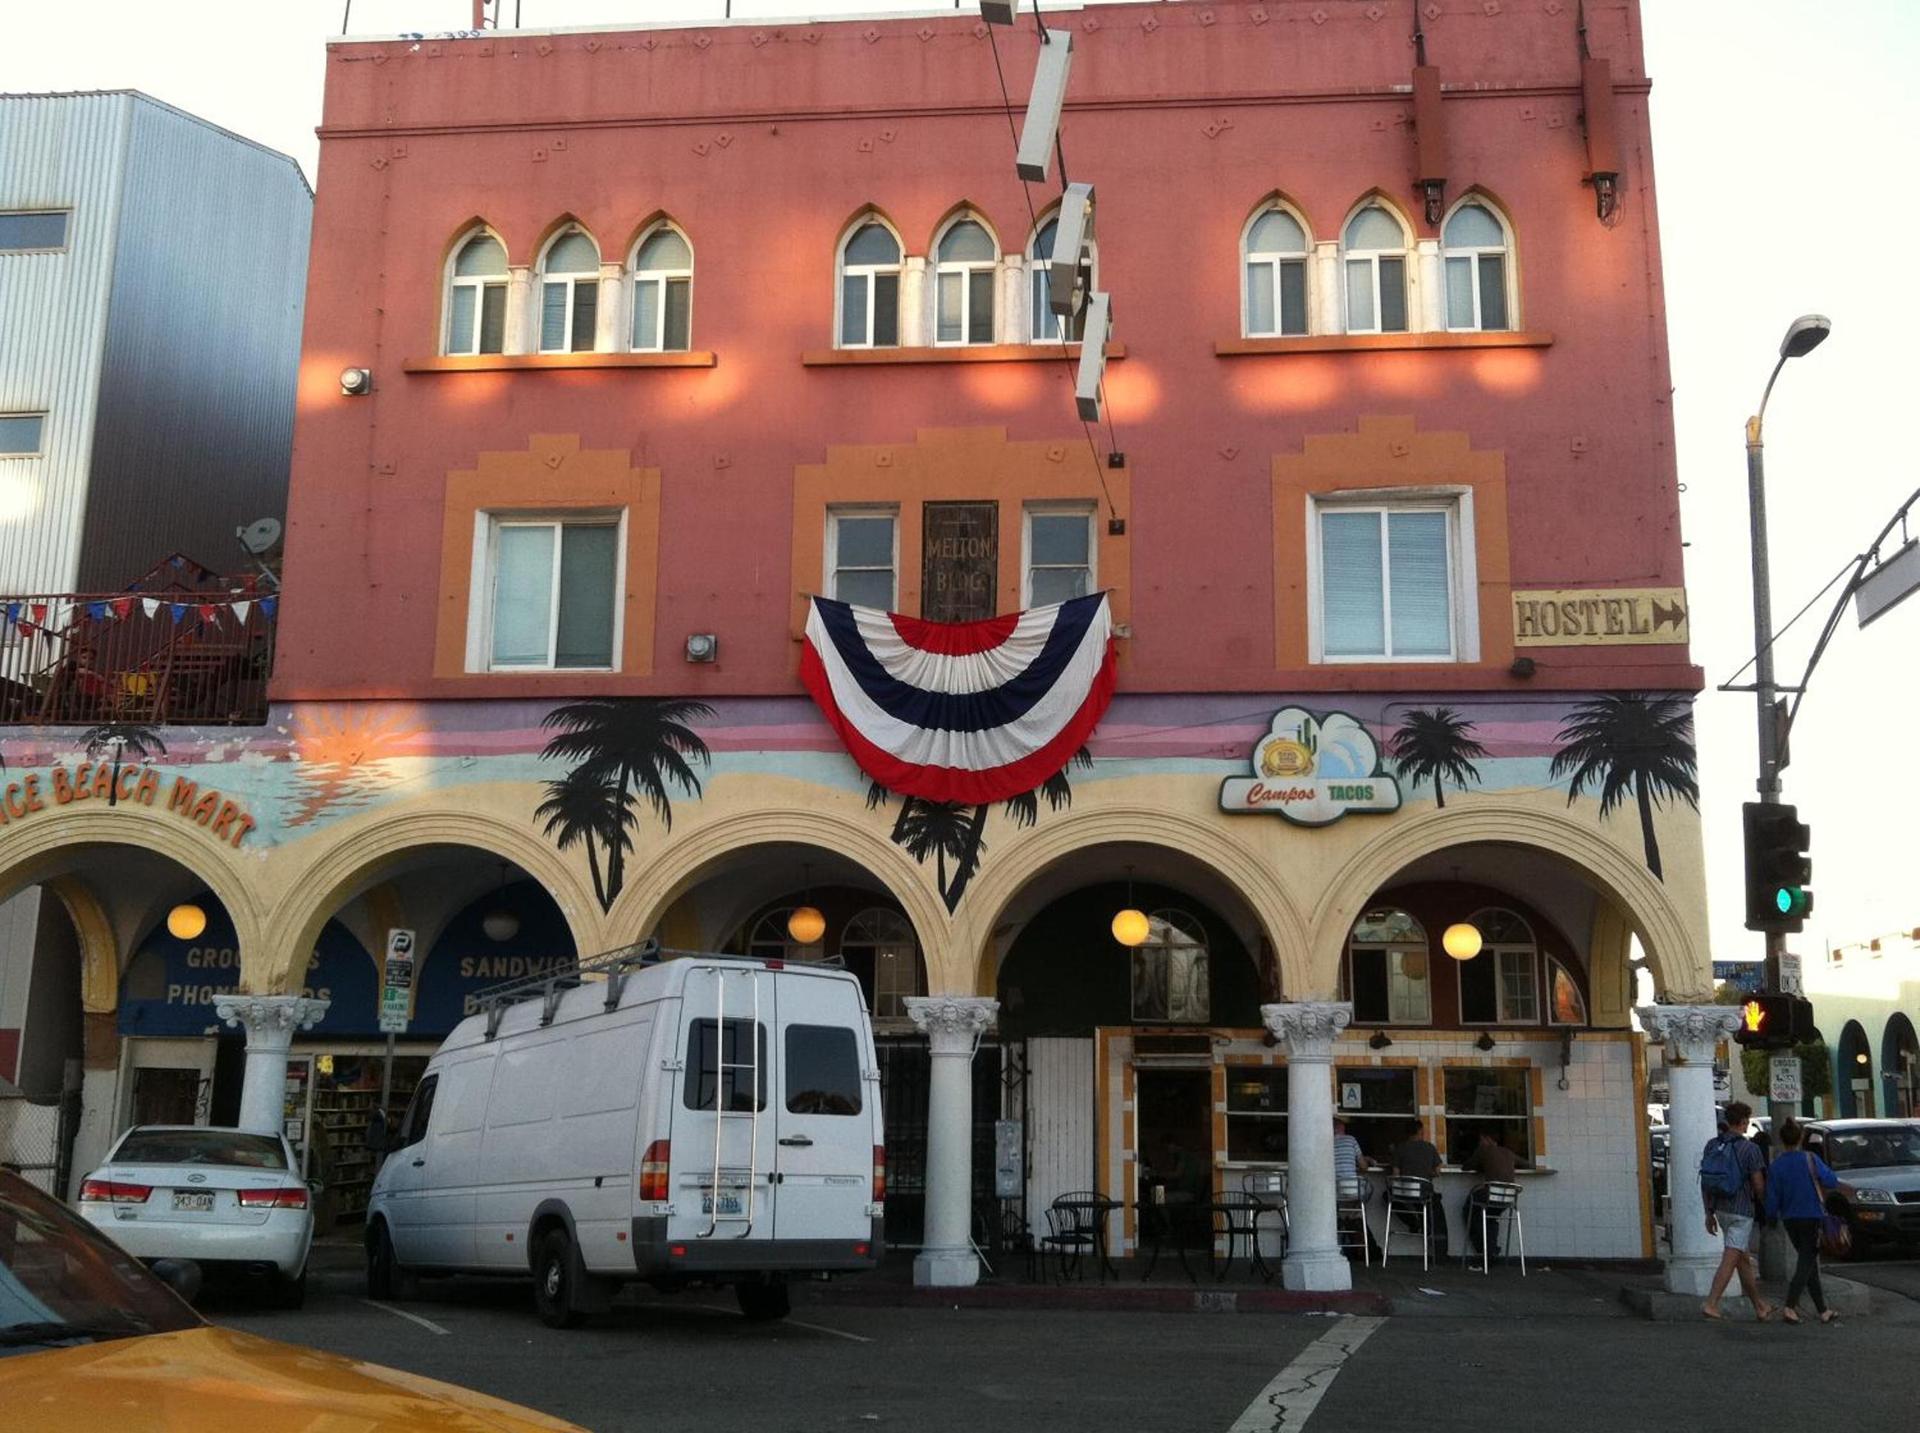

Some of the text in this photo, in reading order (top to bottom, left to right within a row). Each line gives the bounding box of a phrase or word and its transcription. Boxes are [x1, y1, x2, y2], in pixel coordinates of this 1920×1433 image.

[928, 537, 991, 560] MELTON
[1515, 599, 1651, 636] HOSTEL
[52, 762, 161, 806] BEACH
[167, 775, 256, 848] MART
[1247, 783, 1374, 807] Campos TACOS
[1347, 1087, 1357, 1101] A
